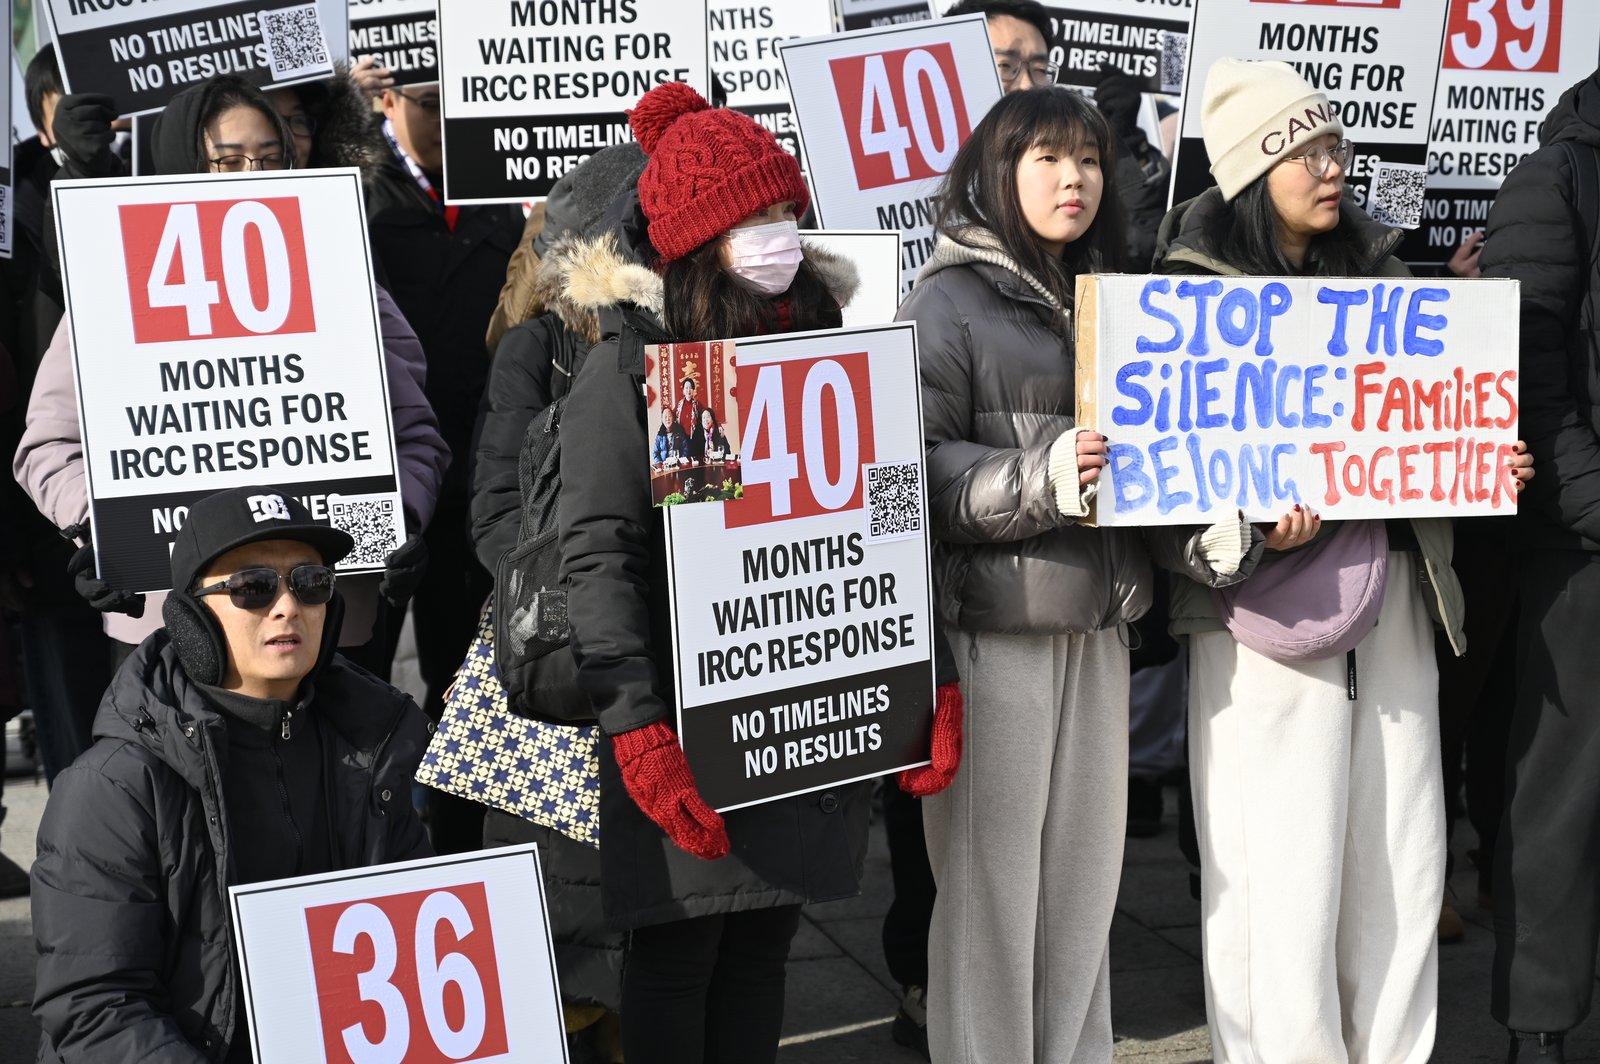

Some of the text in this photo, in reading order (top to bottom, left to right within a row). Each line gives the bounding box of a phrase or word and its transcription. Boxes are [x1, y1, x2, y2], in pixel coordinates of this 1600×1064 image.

[510, 0, 638, 27] MONTHS
[1259, 22, 1380, 54] MONTHS
[1450, 0, 1550, 70] 39
[109, 34, 145, 63] NO
[127, 43, 270, 93] NO RESULTS
[478, 32, 672, 65] WAITING FOR
[462, 74, 527, 103] IRCC
[1350, 63, 1406, 92] FOR
[1447, 85, 1545, 112] MONTHS
[493, 123, 637, 152] NO TIMELIN
[859, 48, 960, 181] 40
[506, 156, 540, 181] NO
[1423, 198, 1450, 220] NO
[1428, 226, 1456, 247] NO
[147, 200, 292, 337] 40
[1136, 277, 1451, 357] STOP THE
[159, 353, 305, 392] MONTHS
[125, 392, 348, 437] WAITING FOR
[739, 358, 859, 517] 40
[109, 431, 372, 480] IRCC RESPONSE
[1308, 436, 1519, 509] TOGETHER
[742, 532, 864, 584] MONTHS
[712, 572, 897, 636] WAITING FOR
[697, 613, 915, 687] IRCC RESPONSE
[731, 684, 890, 743] NO TIMELINES
[744, 723, 882, 778] NO RESULTS
[332, 890, 487, 1064] 36
